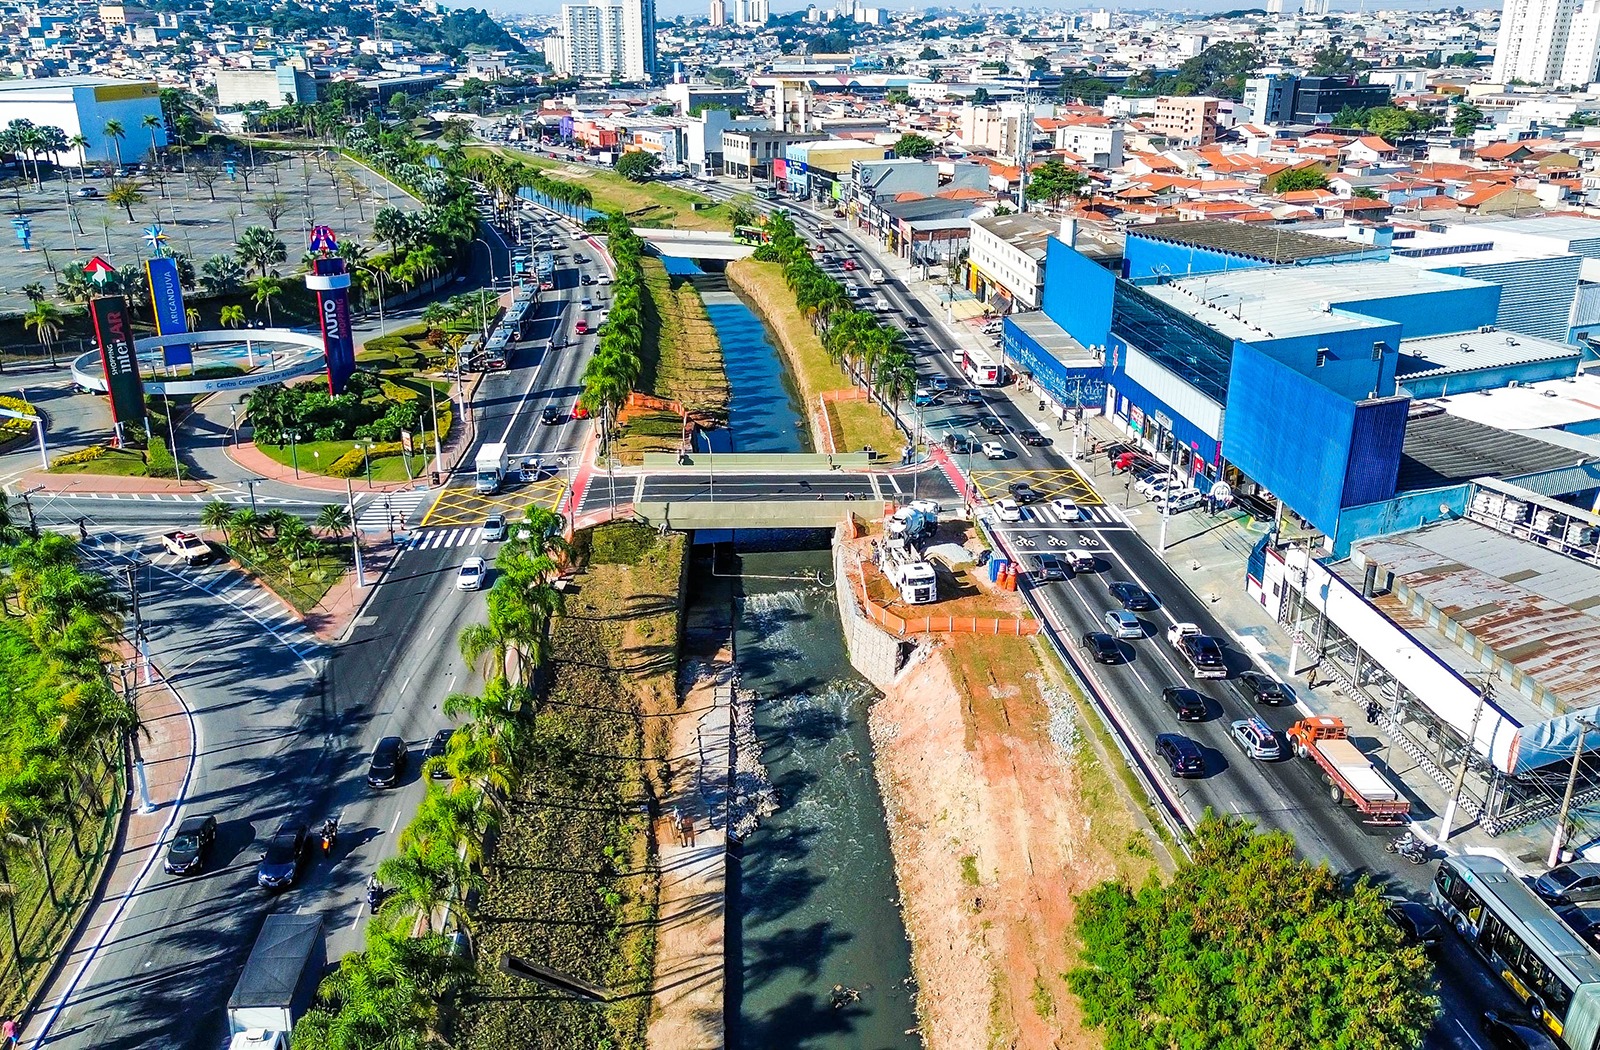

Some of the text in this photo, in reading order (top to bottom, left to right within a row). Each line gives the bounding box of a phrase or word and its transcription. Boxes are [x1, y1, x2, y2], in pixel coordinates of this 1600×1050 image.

[164, 271, 179, 325] ARICANDUVA
[335, 298, 347, 338] SHOPPING
[323, 299, 340, 340] AUTO
[106, 343, 118, 376] SHOPPING
[216, 381, 237, 389] Centro
[239, 375, 267, 386] Comercial
